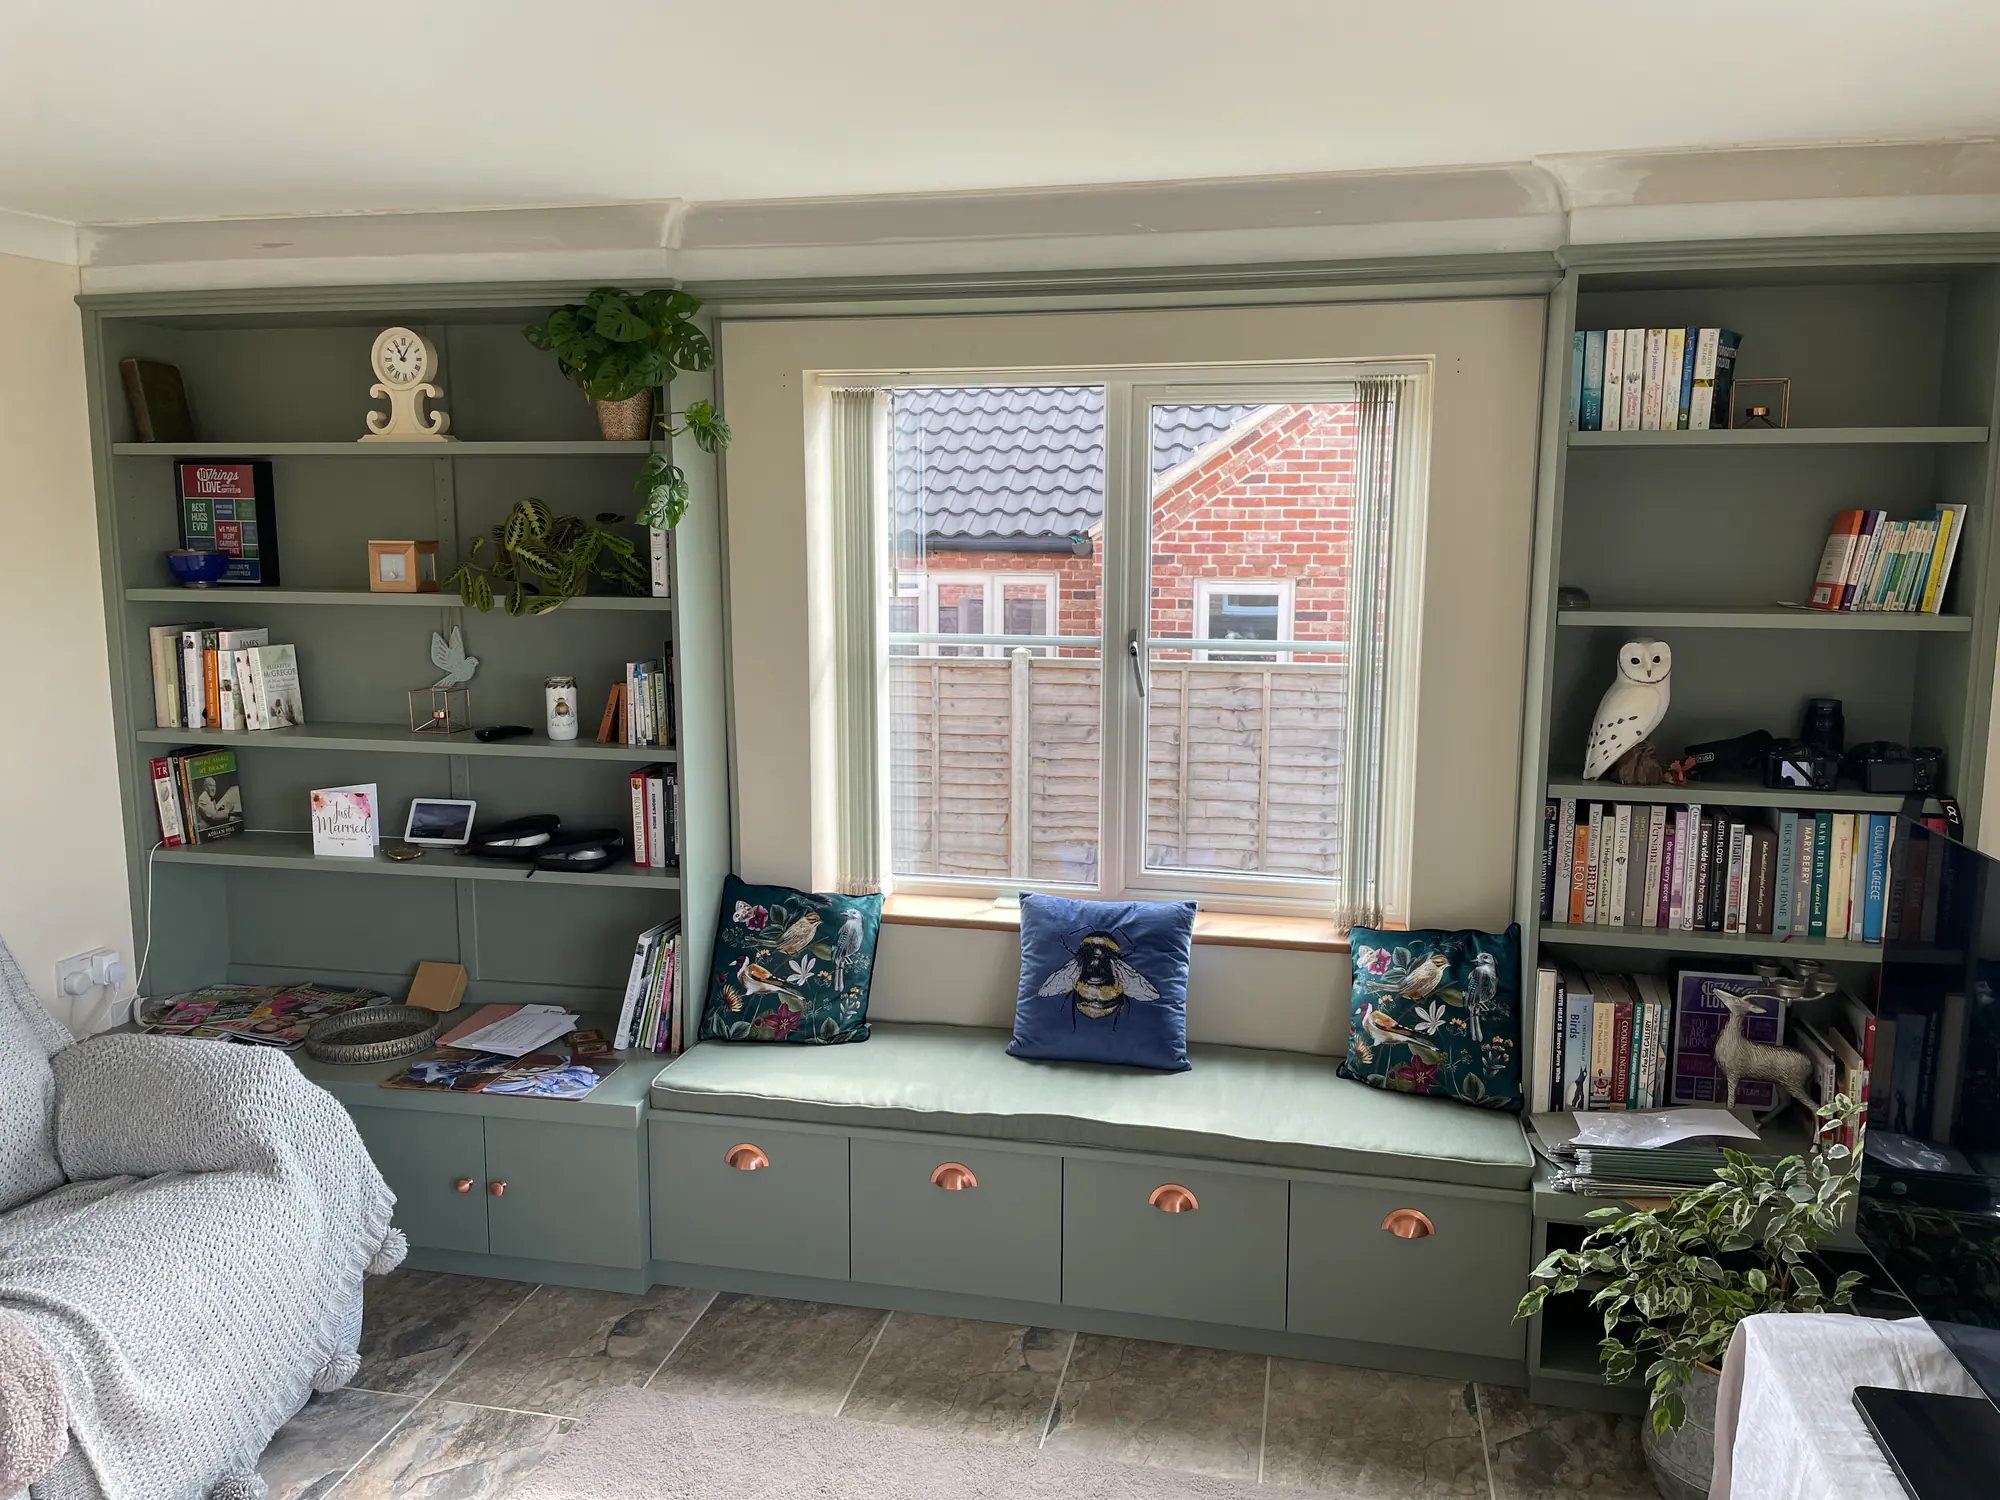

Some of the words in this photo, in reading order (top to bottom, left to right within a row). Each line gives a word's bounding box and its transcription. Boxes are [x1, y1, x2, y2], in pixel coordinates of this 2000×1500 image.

[1705, 343, 1713, 377] FORGOTTEN
[198, 482, 200, 493] I
[202, 481, 221, 493] LOVE
[192, 503, 205, 512] BEST
[192, 513, 207, 521] HUGS
[192, 523, 207, 531] EVER
[240, 639, 259, 648] JAMES
[333, 801, 352, 824] Just
[1566, 801, 1575, 838] GORDON
[1619, 816, 1628, 833] Wild
[313, 816, 372, 834] Married
[635, 822, 643, 850] BRITAIN
[1717, 820, 1725, 841] KEITH
[1783, 823, 1792, 844] RICK
[1818, 823, 1827, 845] MARY
[1589, 825, 1598, 862] Hollywood's
[1618, 836, 1627, 854] Food
[1650, 822, 1662, 863] Persiana
[1803, 826, 1813, 852] MARY
[1872, 825, 1885, 868] CULINARIA
[1563, 840, 1573, 879] RAMSAY'S
[1732, 843, 1742, 865] Balls
[1781, 847, 1791, 873] STEIN
[1816, 850, 1825, 879] BERRY
[1574, 860, 1585, 891] LEON
[1663, 866, 1671, 882] curry
[1699, 873, 1707, 883] the
[1781, 876, 1788, 888] AT
[1801, 855, 1811, 885] BERRY
[1586, 865, 1597, 907] BREAD
[1728, 875, 1740, 909] APPETITE
[1870, 869, 1882, 900] GREECE
[1779, 890, 1788, 917] HOME
[1569, 1014, 1580, 1039] Birds
[1691, 1018, 1708, 1029] YOU
[1619, 1021, 1629, 1054] COOKING
[1685, 1038, 1709, 1048] HOME
[1617, 1056, 1627, 1101] INGREDIENTS
[1742, 1088, 1760, 1097] TEAM
